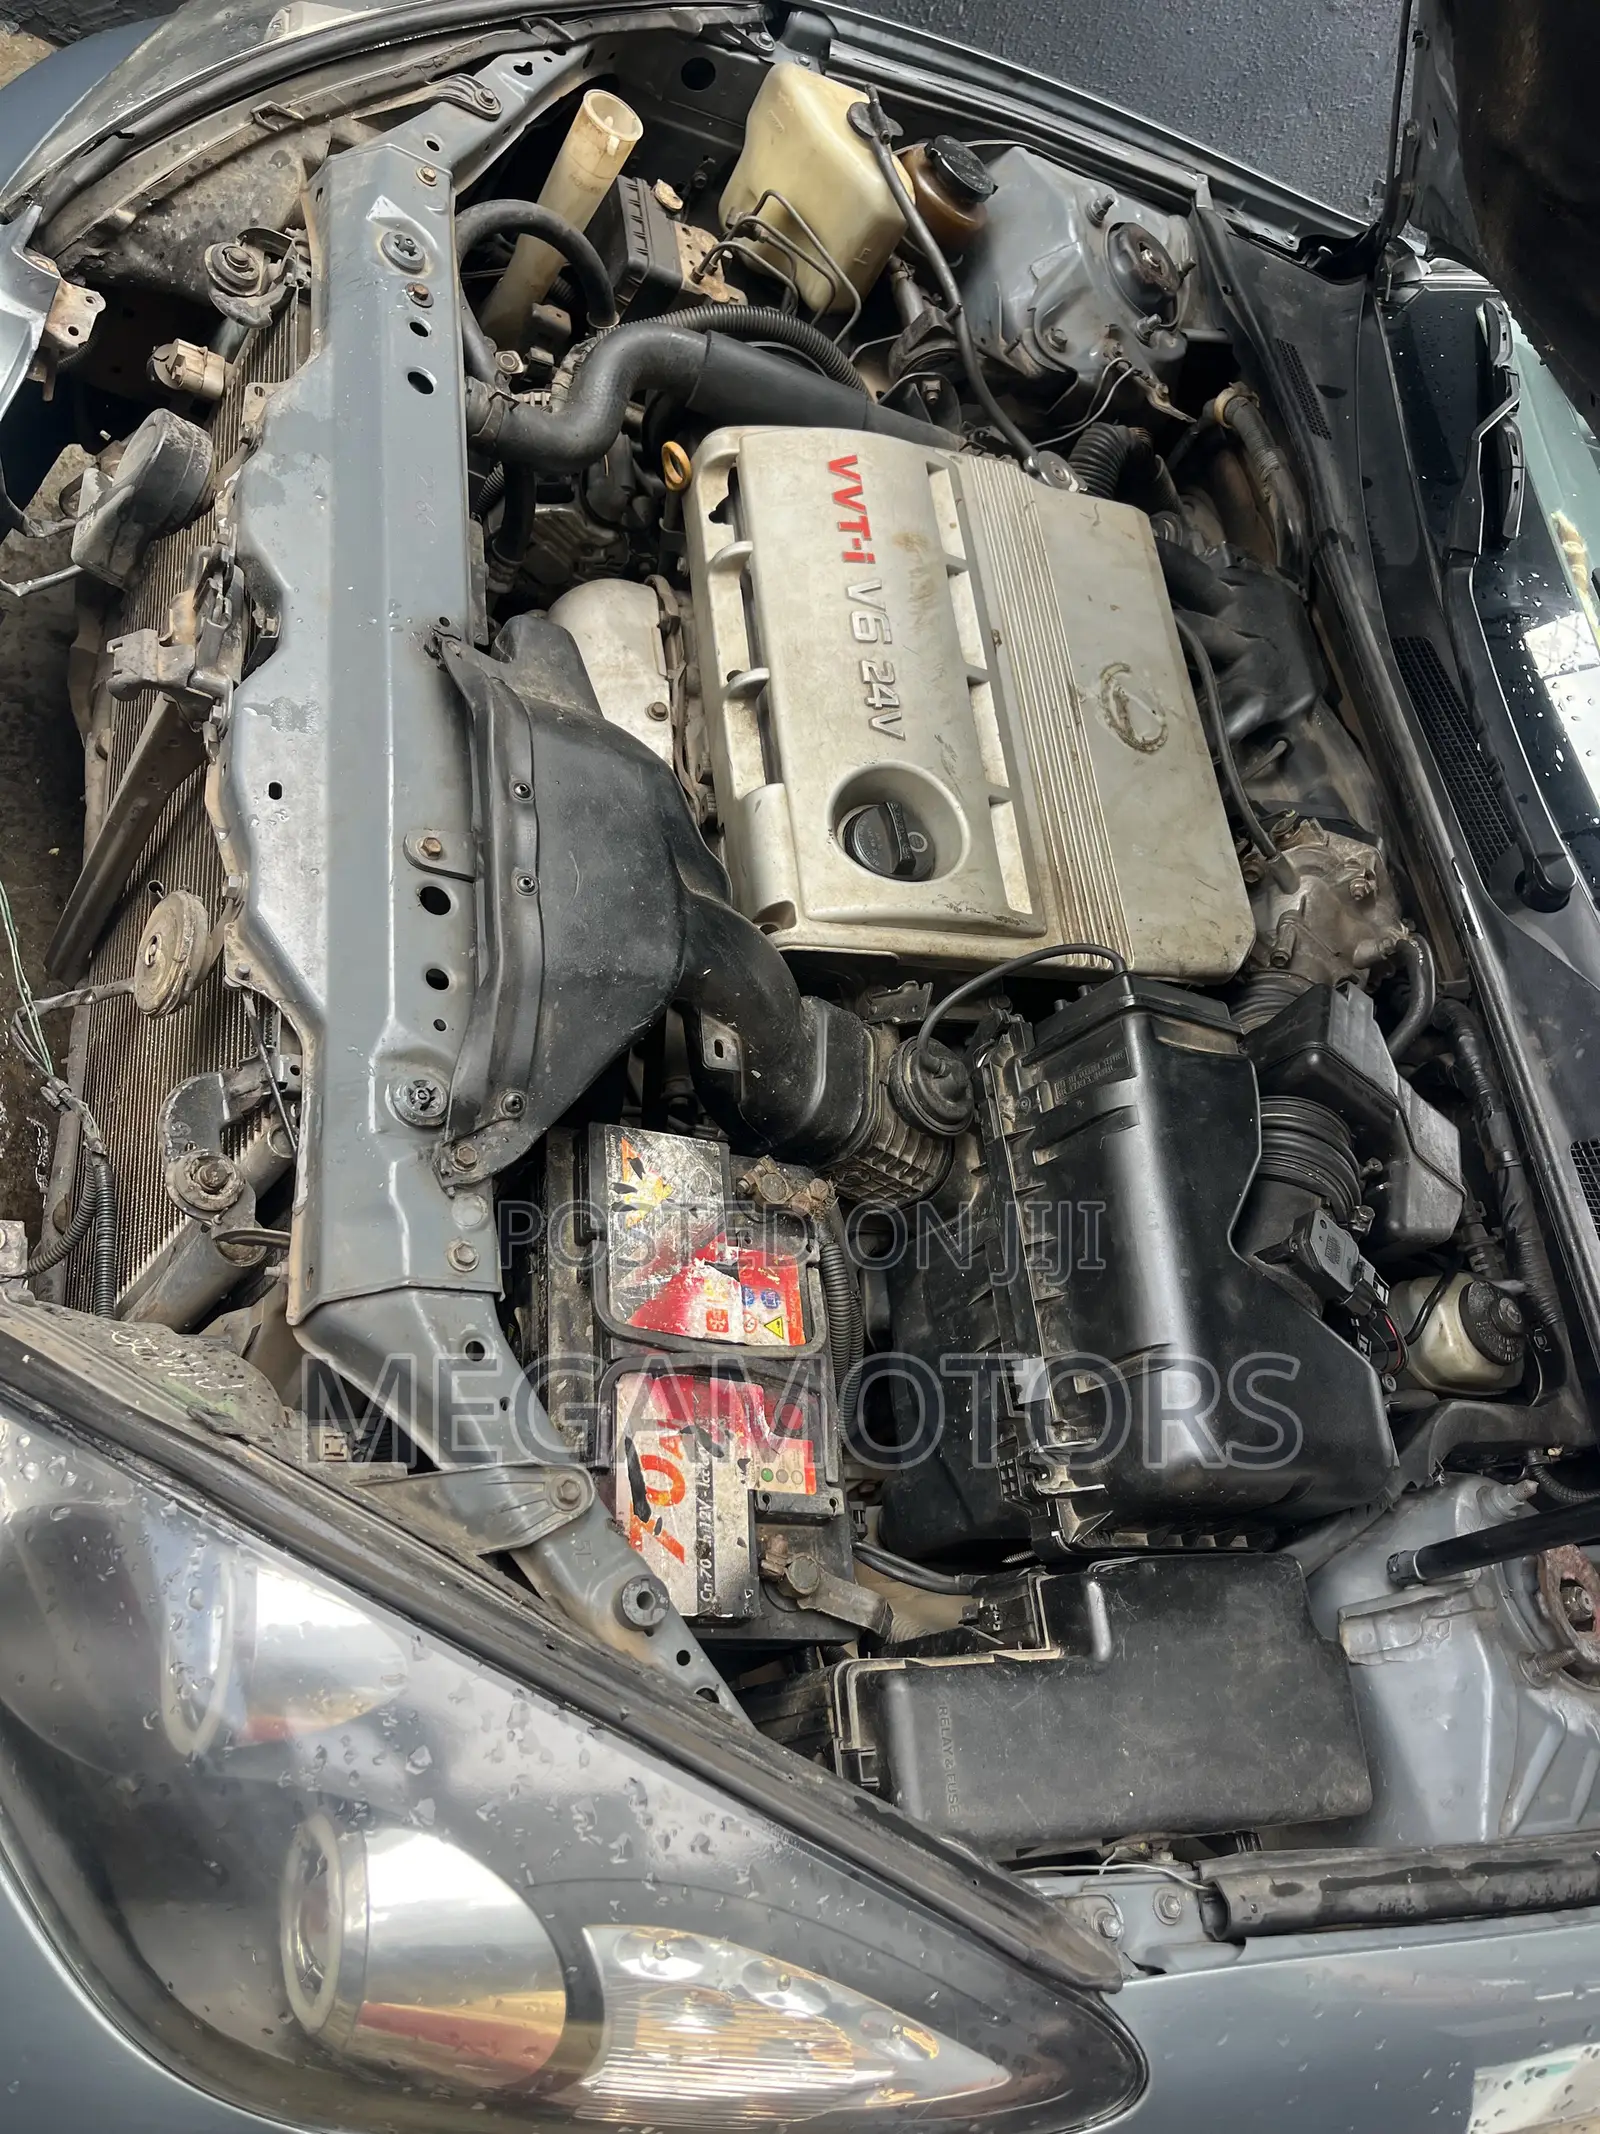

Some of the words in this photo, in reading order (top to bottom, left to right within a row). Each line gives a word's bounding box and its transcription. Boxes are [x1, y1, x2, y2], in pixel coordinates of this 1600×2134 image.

[828, 454, 876, 564] VVT-i
[847, 578, 893, 645] V6
[859, 658, 906, 741] 24V
[938, 1706, 954, 1756] RELAY
[943, 1758, 954, 1769] &
[945, 1772, 960, 1815] FUSE
